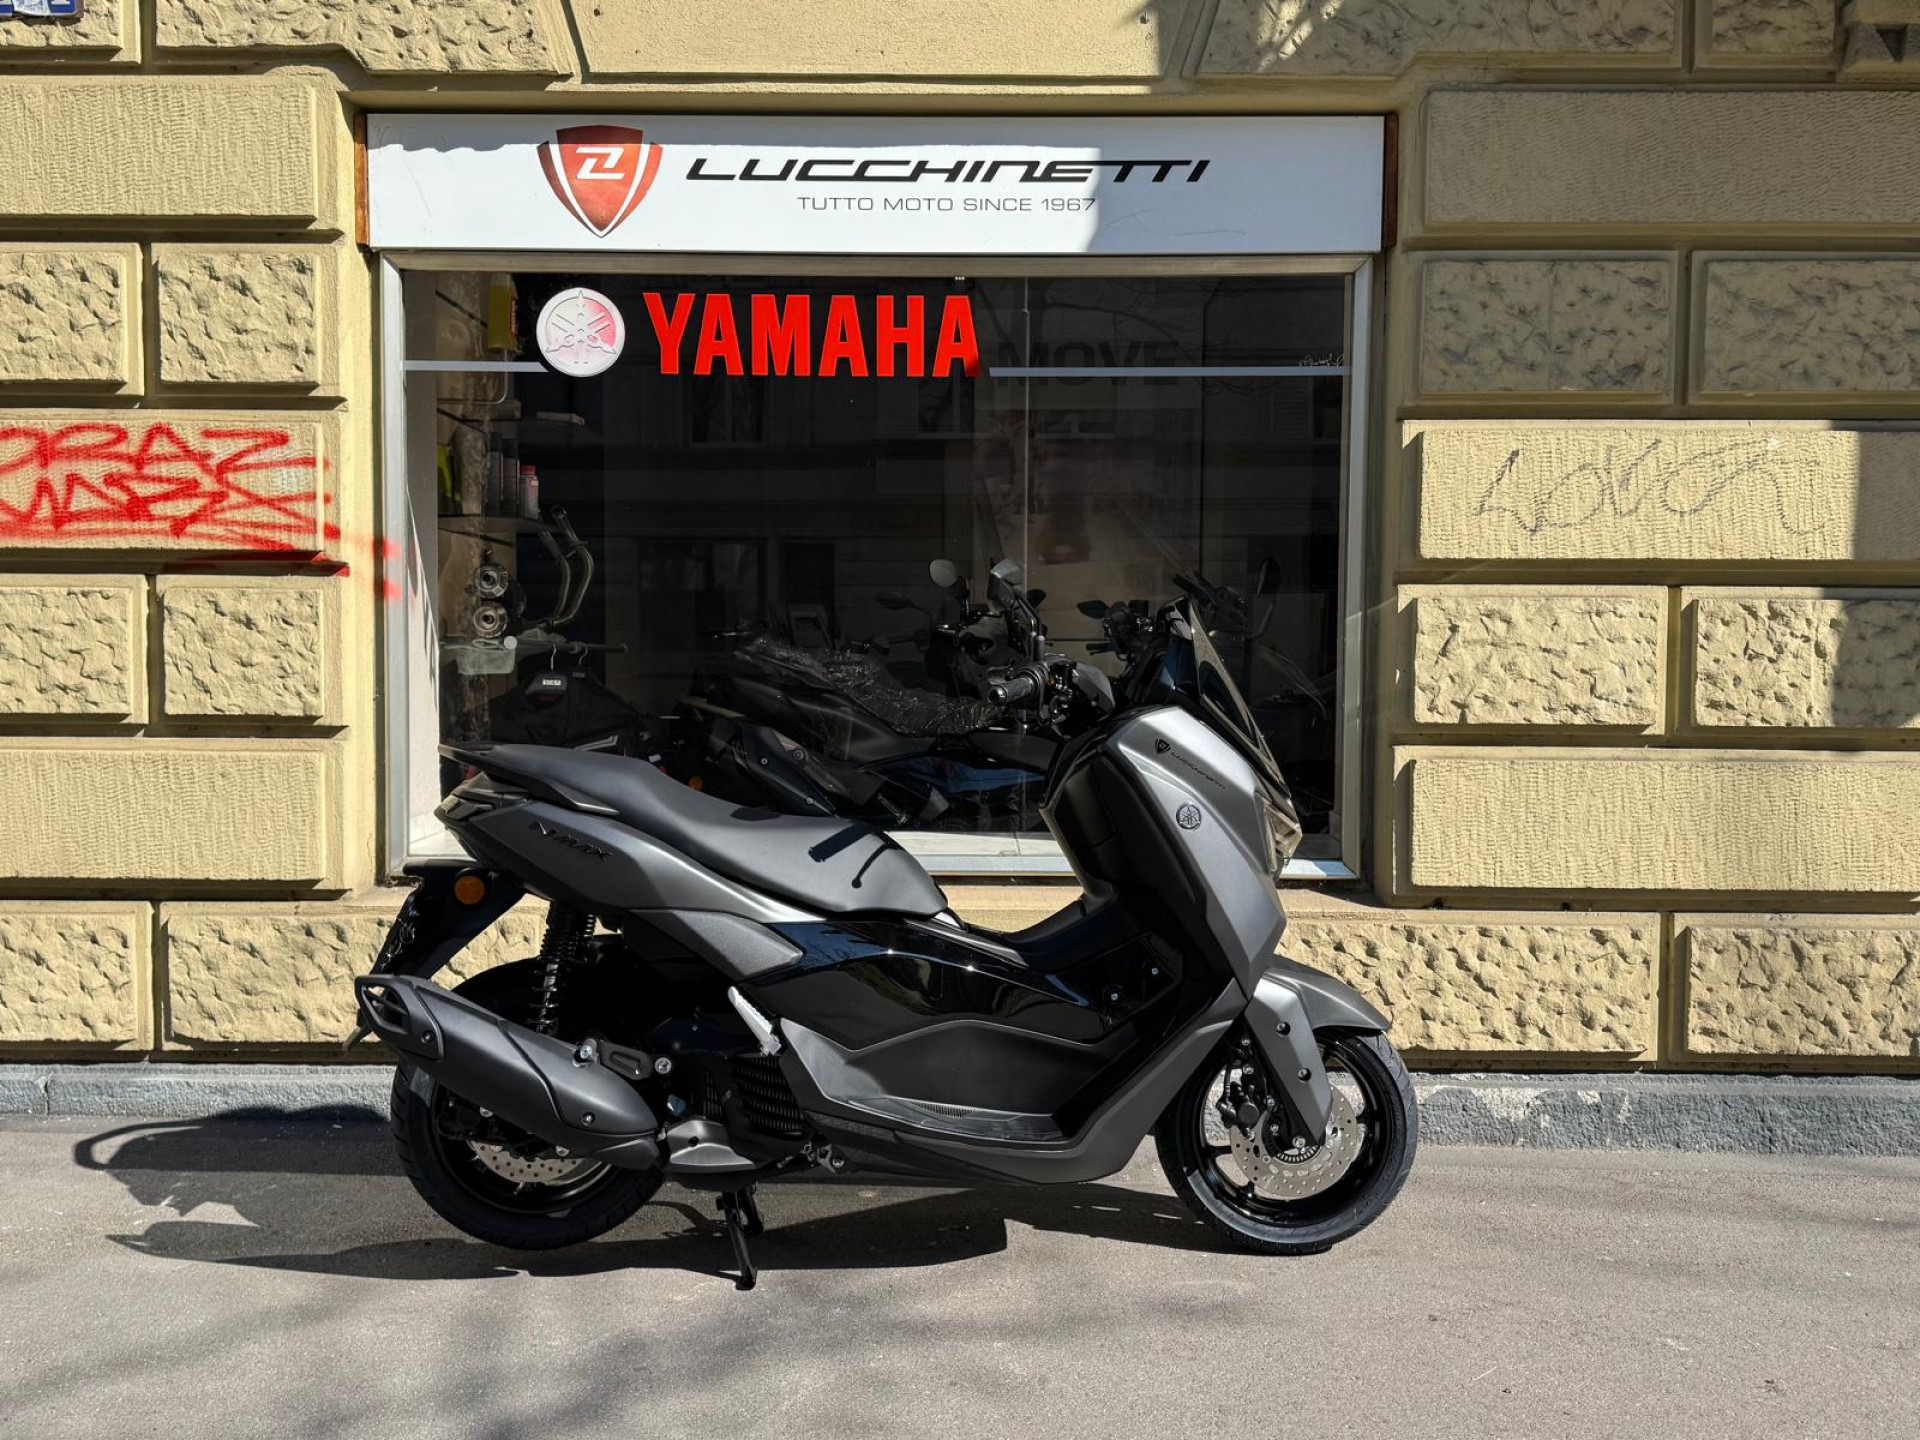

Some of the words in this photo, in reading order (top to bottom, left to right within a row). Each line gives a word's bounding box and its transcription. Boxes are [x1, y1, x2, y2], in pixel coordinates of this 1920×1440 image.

[686, 158, 1211, 183] LUCCHINETTI
[797, 197, 874, 211] TUTTO
[883, 197, 954, 211] MOTO
[963, 197, 1033, 211] SINCE
[1040, 197, 1096, 211] 1967
[643, 292, 981, 377] YAMAHA
[997, 340, 1179, 387] MOVE
